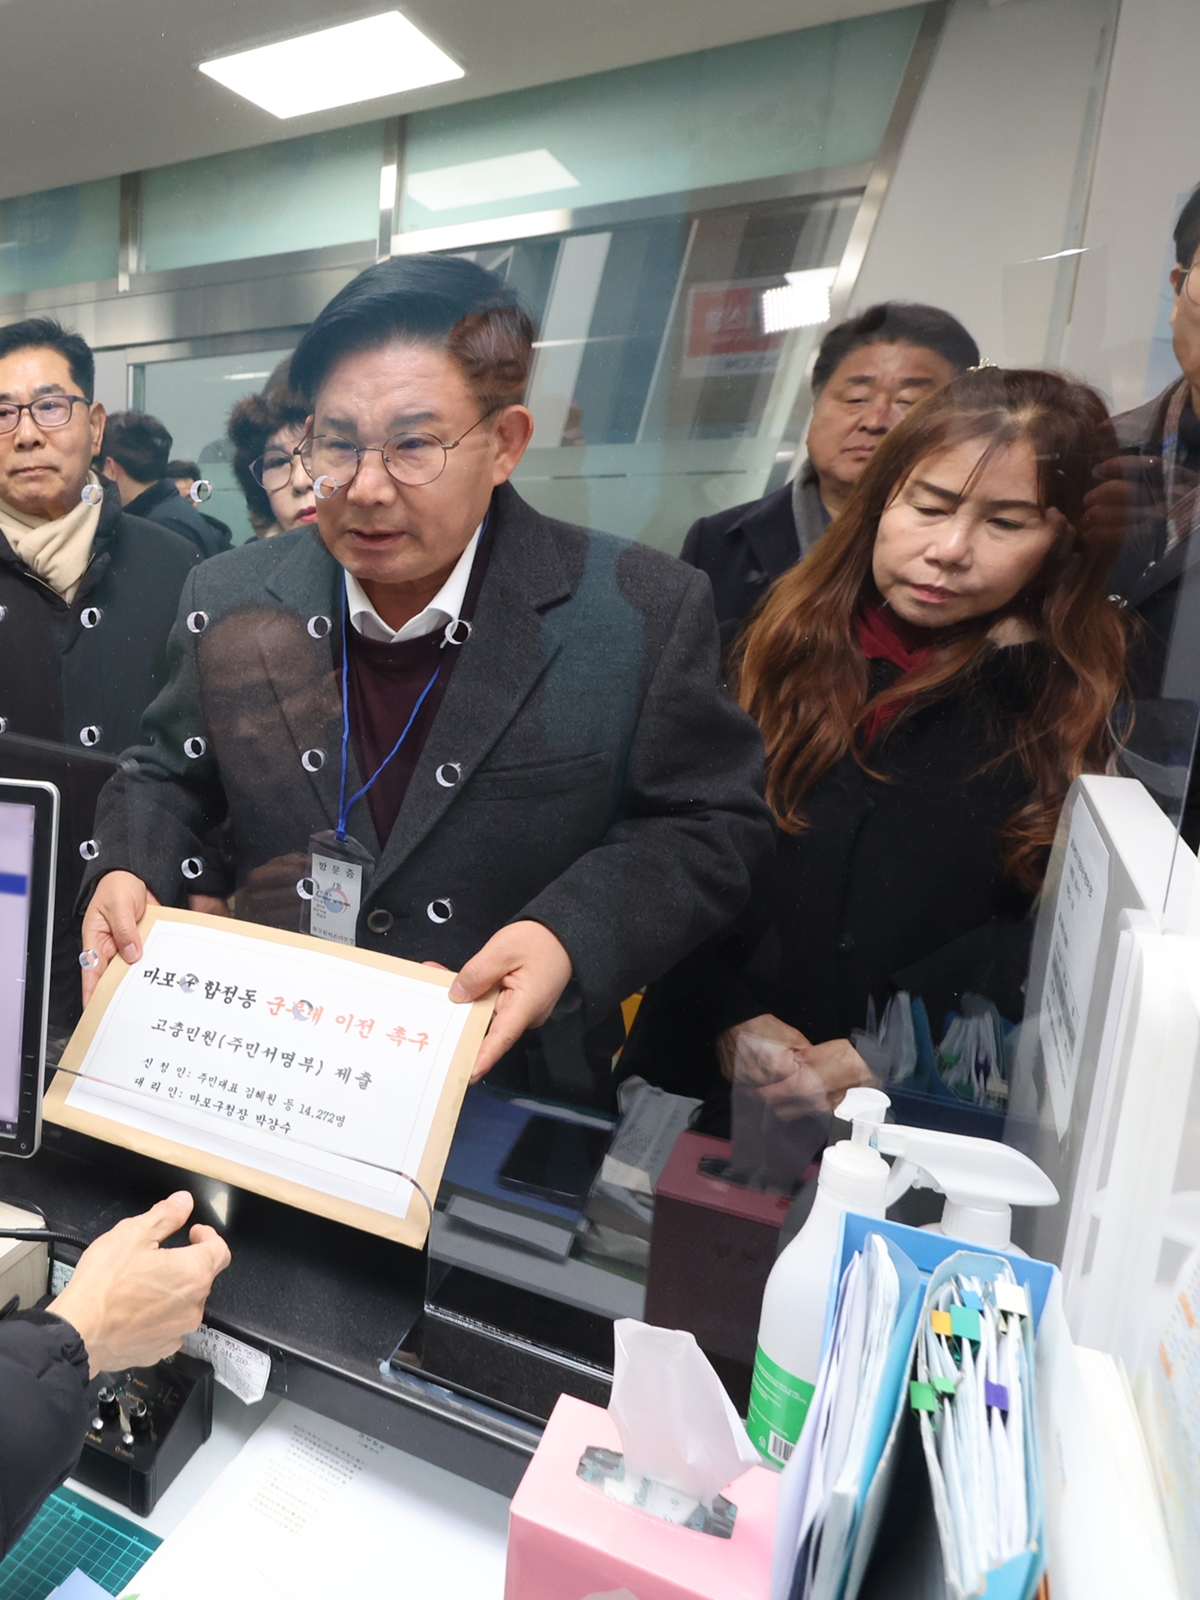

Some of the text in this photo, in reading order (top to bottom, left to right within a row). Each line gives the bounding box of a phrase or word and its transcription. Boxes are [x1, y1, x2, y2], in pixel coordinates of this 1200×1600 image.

[204, 980, 257, 1010] 합정동
[335, 1013, 375, 1039] 이전
[385, 1025, 429, 1053] 촉구
[197, 1072, 238, 1093] 주민대표
[245, 1087, 277, 1106] 김혜원
[283, 1098, 294, 1112] 등
[334, 1066, 372, 1090] 제출
[190, 1093, 248, 1121] 마포구청장
[255, 1113, 291, 1135] 박강수
